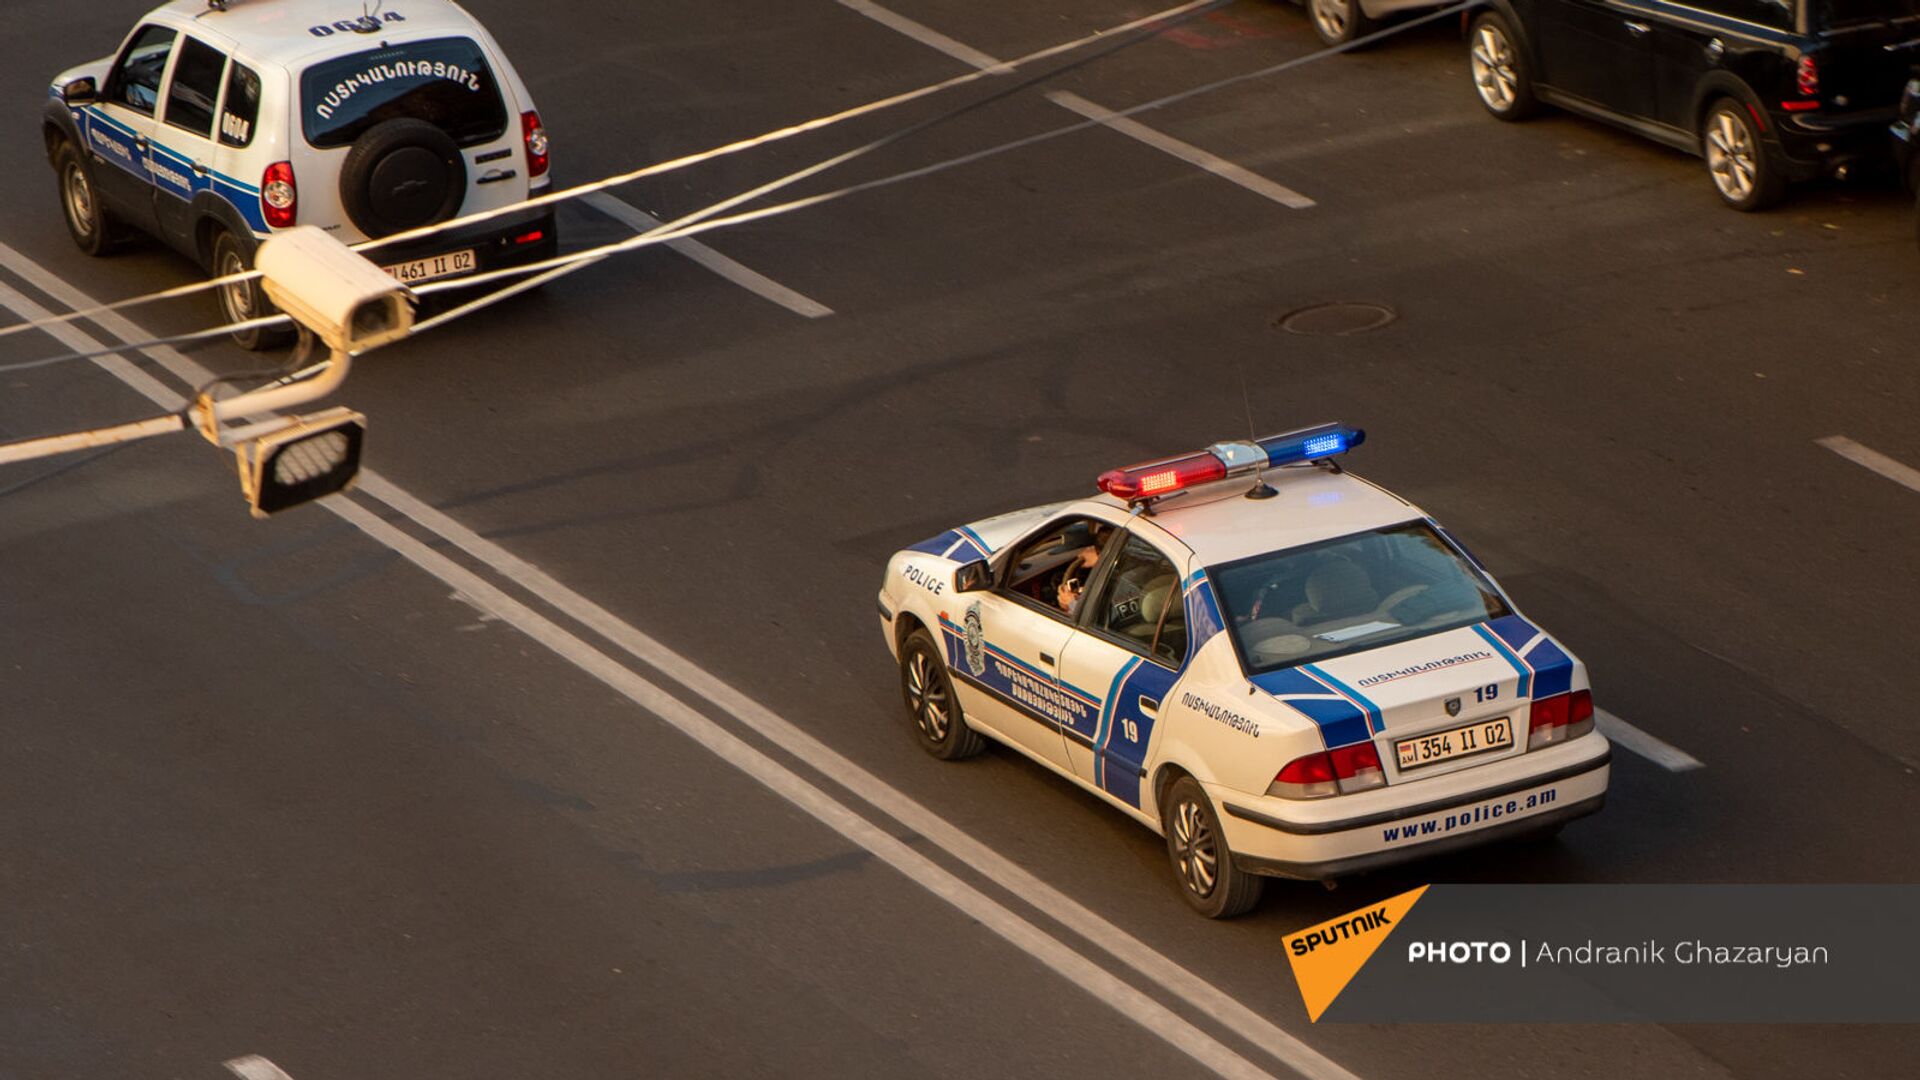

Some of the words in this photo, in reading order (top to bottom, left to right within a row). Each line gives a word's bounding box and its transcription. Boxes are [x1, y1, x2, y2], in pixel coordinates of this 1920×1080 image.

[316, 60, 481, 119] ՈՍՏԻԿԱՆՈՒԹՅՈՒՆ
[401, 262, 427, 280] 461
[434, 257, 447, 274] II
[453, 252, 471, 270] 02
[903, 564, 945, 596] POLICE
[1358, 650, 1491, 687] ՈՍՏԻԿԱՆՈՒԹՅՈՒՆ
[1473, 683, 1499, 703] 19
[1121, 718, 1139, 744] 19
[1181, 691, 1260, 738] ՈՍՏԻԿԱՆՈՒԹՅՈՒՆ
[1420, 735, 1452, 760] 354
[1460, 729, 1477, 752] II
[1485, 723, 1506, 745] 02
[1402, 754, 1414, 765] AM
[1383, 788, 1557, 842] www.police.am
